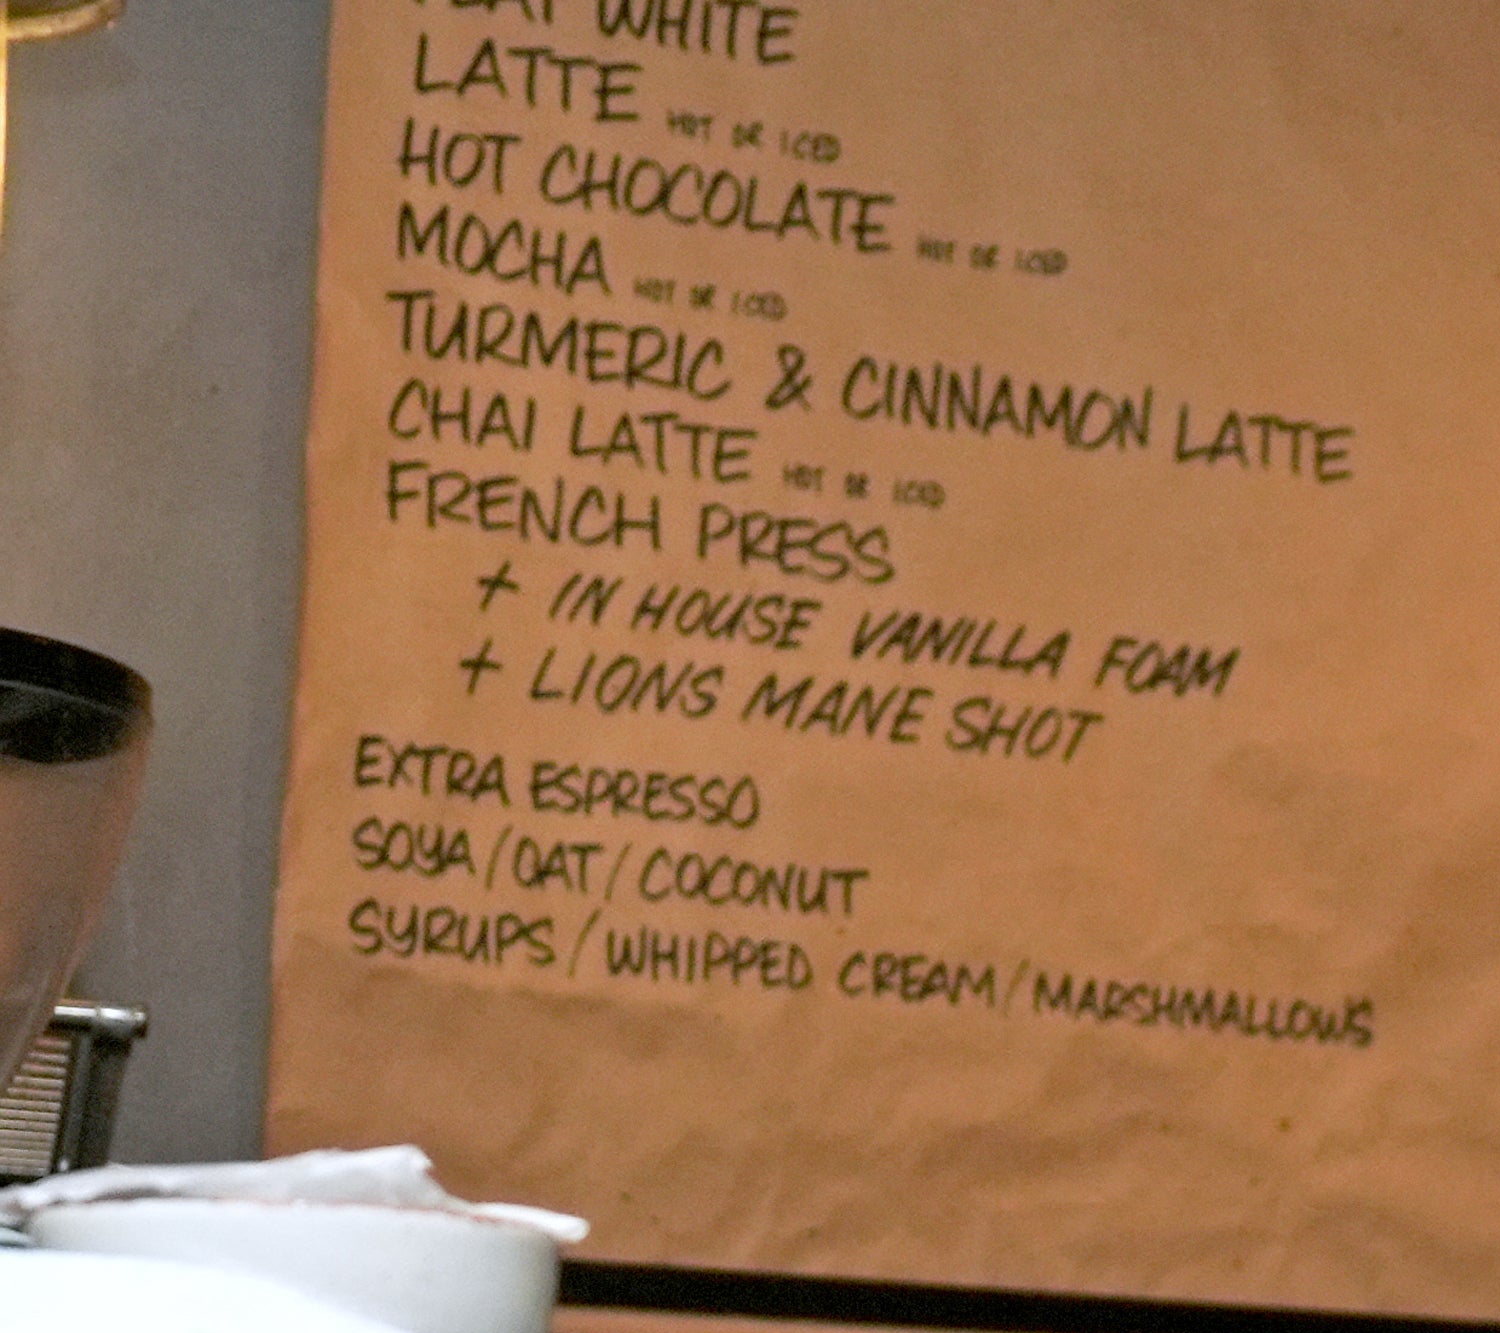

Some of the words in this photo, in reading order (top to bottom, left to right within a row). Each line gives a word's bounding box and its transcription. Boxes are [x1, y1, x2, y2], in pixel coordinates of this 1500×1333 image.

[413, 34, 643, 122] LATTE
[600, 0, 799, 65] WHITE
[397, 117, 520, 194] HOT
[539, 143, 896, 255] CHOCOLATE
[397, 203, 611, 297] MOCHA
[386, 290, 731, 400] TURMERIC
[765, 344, 814, 412] &
[841, 356, 1153, 452] CINNAMON
[1174, 403, 1356, 484] LATTE
[387, 378, 538, 451] CHAI
[569, 405, 759, 484] LATTE
[386, 461, 661, 551] FRENCH
[699, 503, 894, 587] PRESS
[549, 573, 623, 625] IN
[630, 581, 820, 653] HOUSE
[851, 610, 1071, 678] VANILLA
[1095, 634, 1241, 699] FOAM
[529, 648, 725, 719] LIONS
[741, 676, 933, 745] MANE
[945, 697, 1105, 763] SHOT
[353, 734, 510, 806] EXTRA
[528, 761, 762, 830] ESPRESSO
